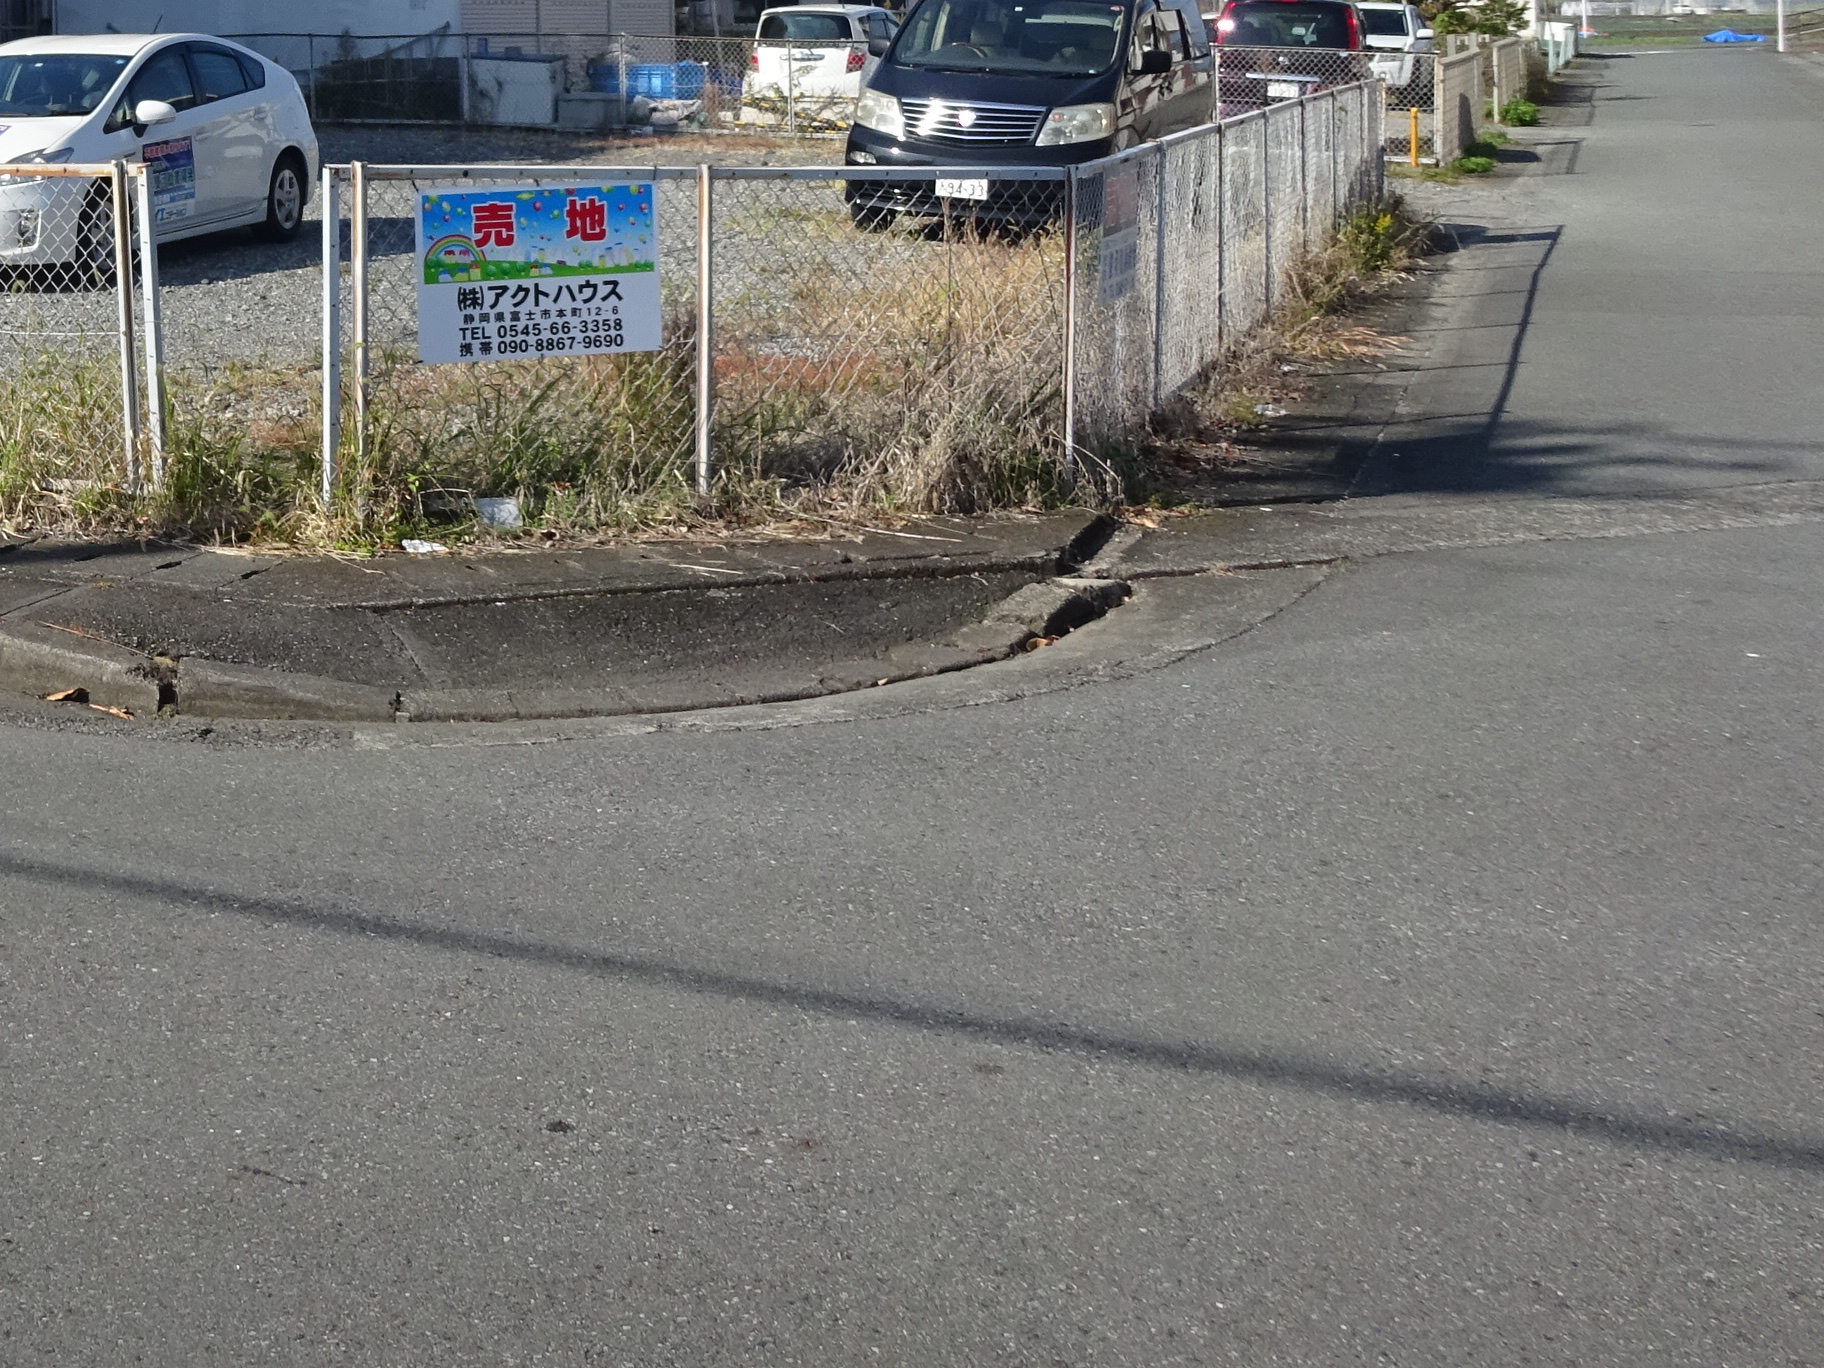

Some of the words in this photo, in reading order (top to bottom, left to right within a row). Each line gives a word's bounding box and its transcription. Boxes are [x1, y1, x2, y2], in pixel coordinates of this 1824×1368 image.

[471, 197, 607, 248] 売地
[463, 305, 619, 325] 静岡県富士市本町12-6
[459, 326, 491, 341] TEL
[497, 318, 623, 338] 0545-66-3358
[459, 340, 493, 358] 携帯
[497, 333, 624, 354] 090-8867-9690
